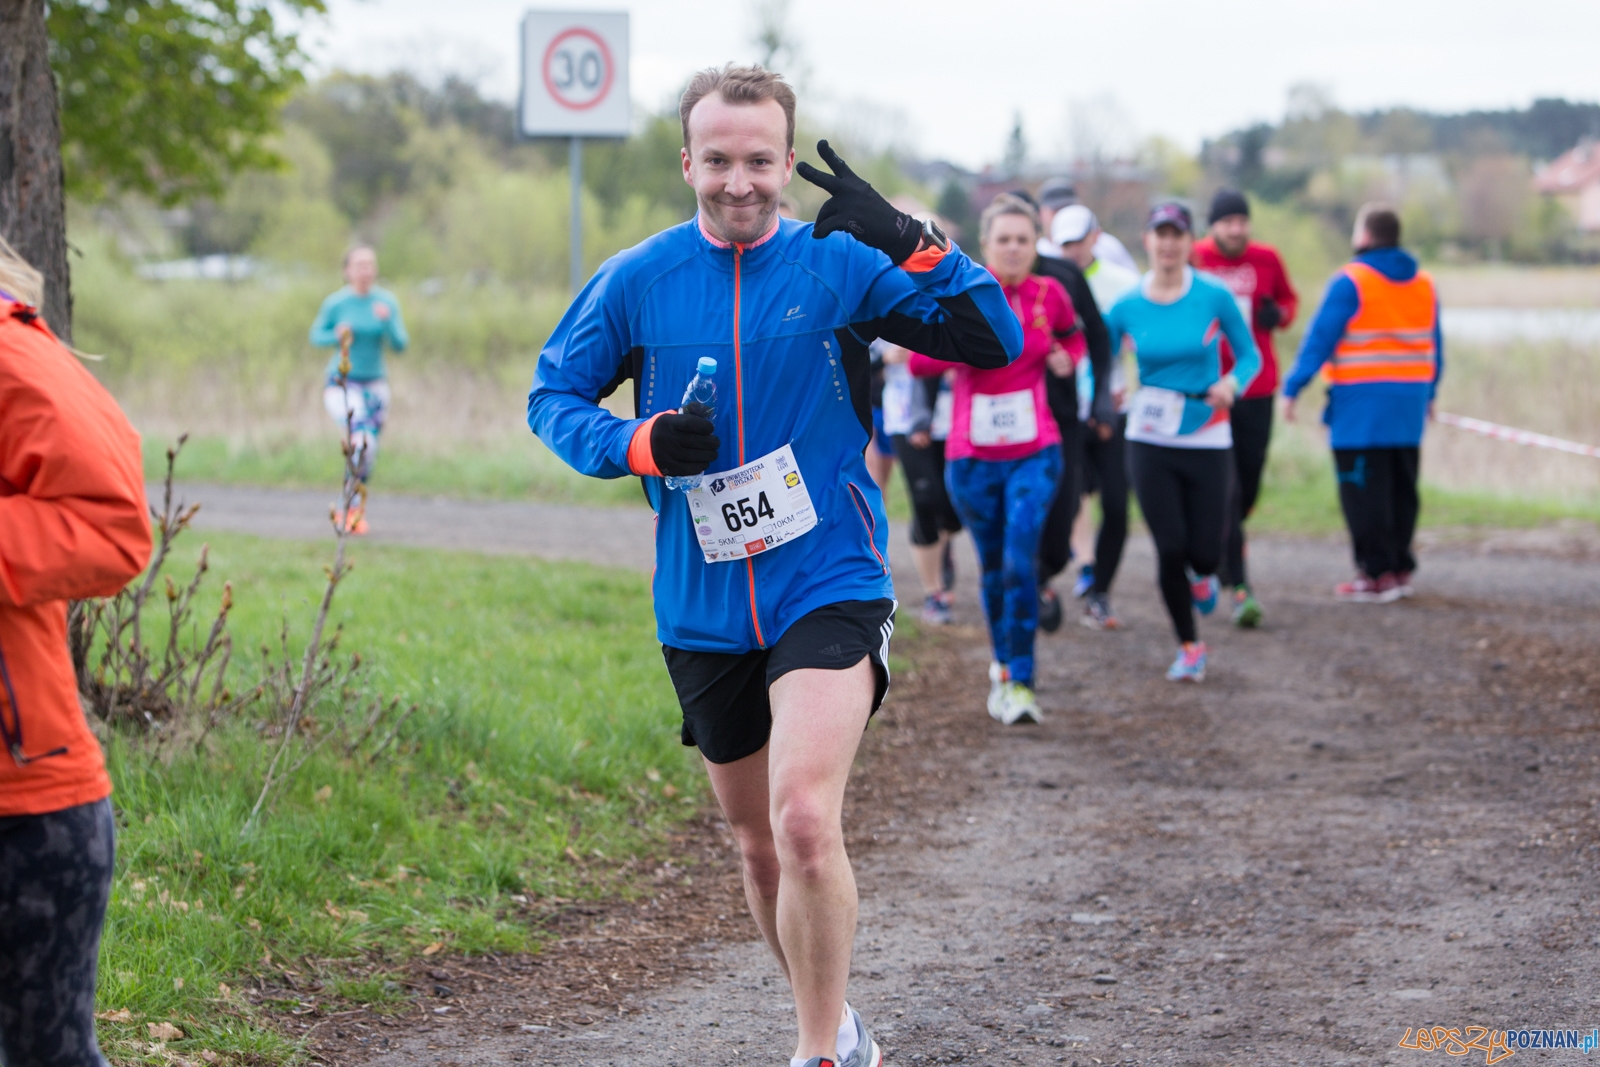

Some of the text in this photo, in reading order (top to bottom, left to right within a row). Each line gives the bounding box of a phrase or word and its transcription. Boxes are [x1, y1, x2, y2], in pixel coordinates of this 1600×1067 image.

[554, 49, 603, 90] 30
[725, 463, 765, 482] UNIWERSYTECKA
[753, 471, 762, 481] IV
[721, 491, 774, 533] 654
[772, 514, 795, 530] 10KM
[718, 536, 736, 547] 5KM
